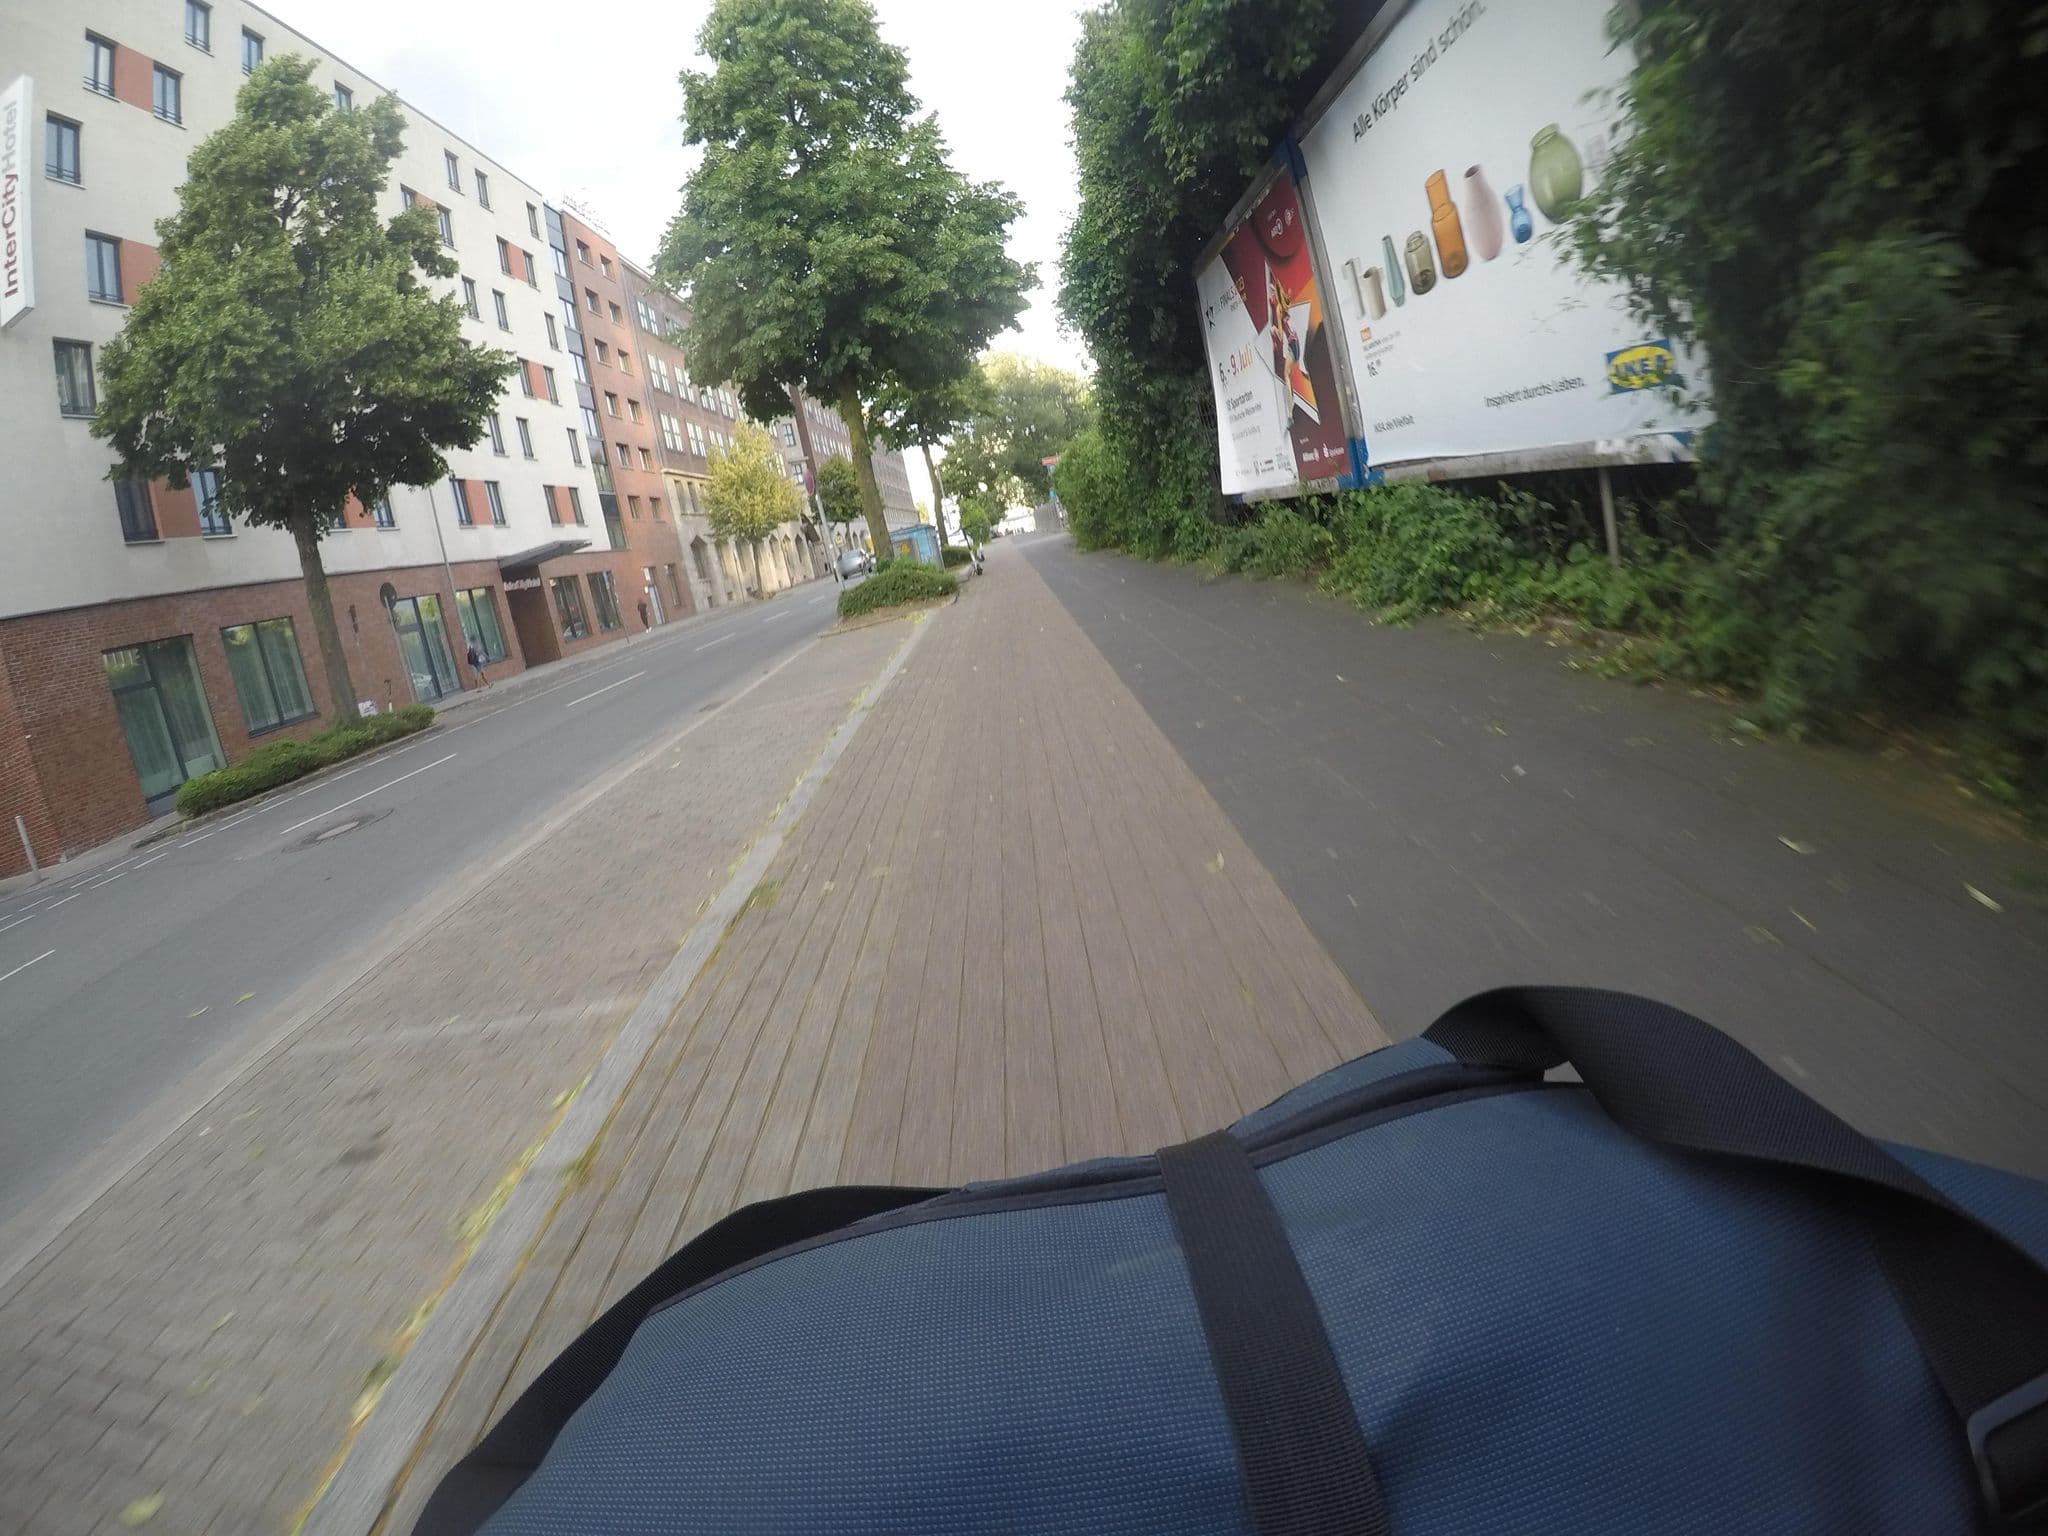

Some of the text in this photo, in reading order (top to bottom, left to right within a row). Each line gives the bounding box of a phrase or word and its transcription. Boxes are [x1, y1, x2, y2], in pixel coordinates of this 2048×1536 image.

[1352, 0, 1486, 143] Alle Körper sind schön.
[1, 100, 19, 299] InterCityHotel
[1612, 353, 1669, 379] IKEA
